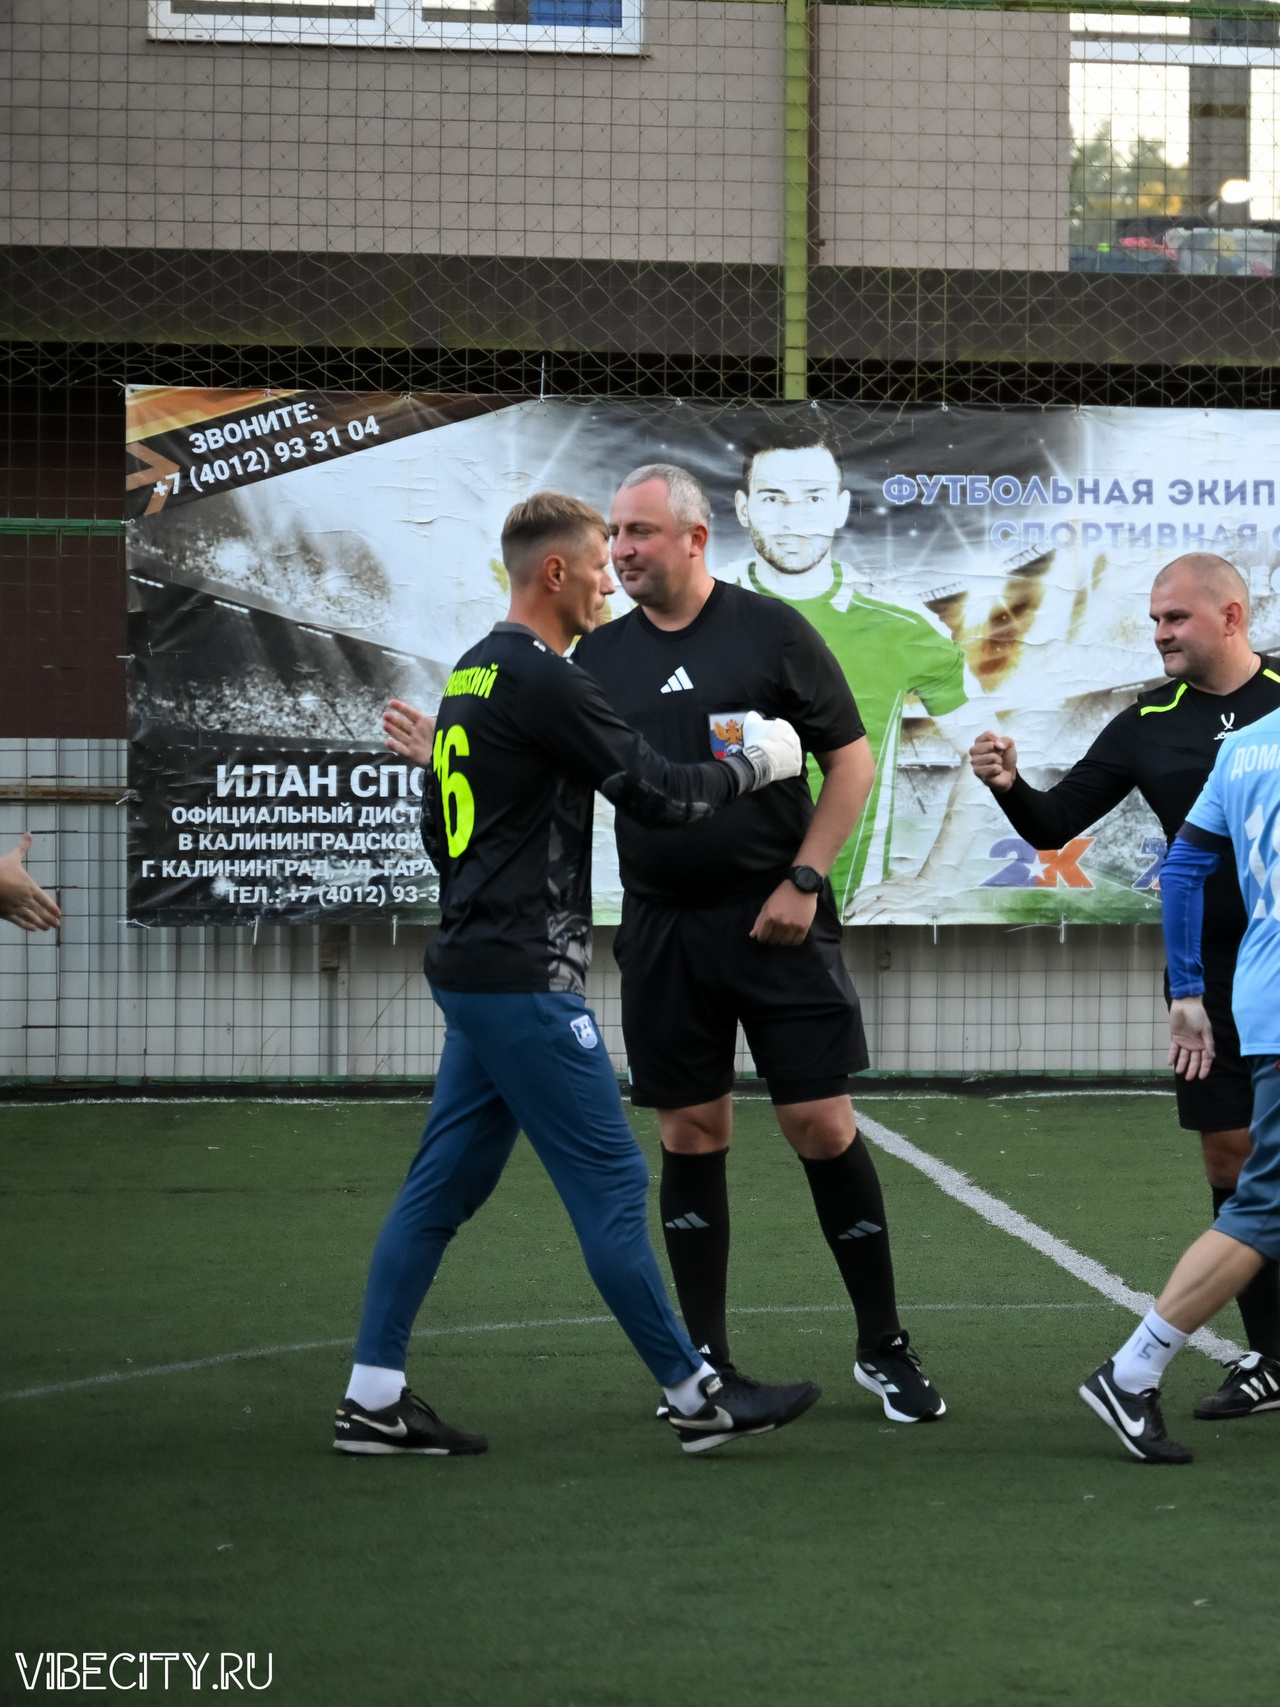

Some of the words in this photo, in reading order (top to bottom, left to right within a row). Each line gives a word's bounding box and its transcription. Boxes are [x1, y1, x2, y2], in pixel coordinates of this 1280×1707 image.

[188, 401, 318, 455] ЗВОНИТЕ:
[153, 471, 181, 497] +7
[189, 447, 271, 492] (4012)
[273, 436, 308, 465] 93
[310, 429, 342, 452] 31
[347, 415, 381, 442] 04
[882, 474, 1154, 506] ФУТБОЛЬНАЯ
[990, 520, 1259, 551] СПОРТИВНАЯ
[217, 764, 338, 798] ИЛАН
[171, 802, 353, 825] ОФИЦИАЛЬНЫЙ
[358, 806, 422, 827] ДИСТ
[178, 833, 193, 851] В
[141, 860, 156, 878] Г.
[162, 859, 335, 881] КАЛИНИНГРАД,
[384, 860, 440, 877] ГАРА
[226, 886, 281, 904] ТЕЛ.:
[287, 885, 312, 903] +7
[319, 885, 386, 907] (4012)
